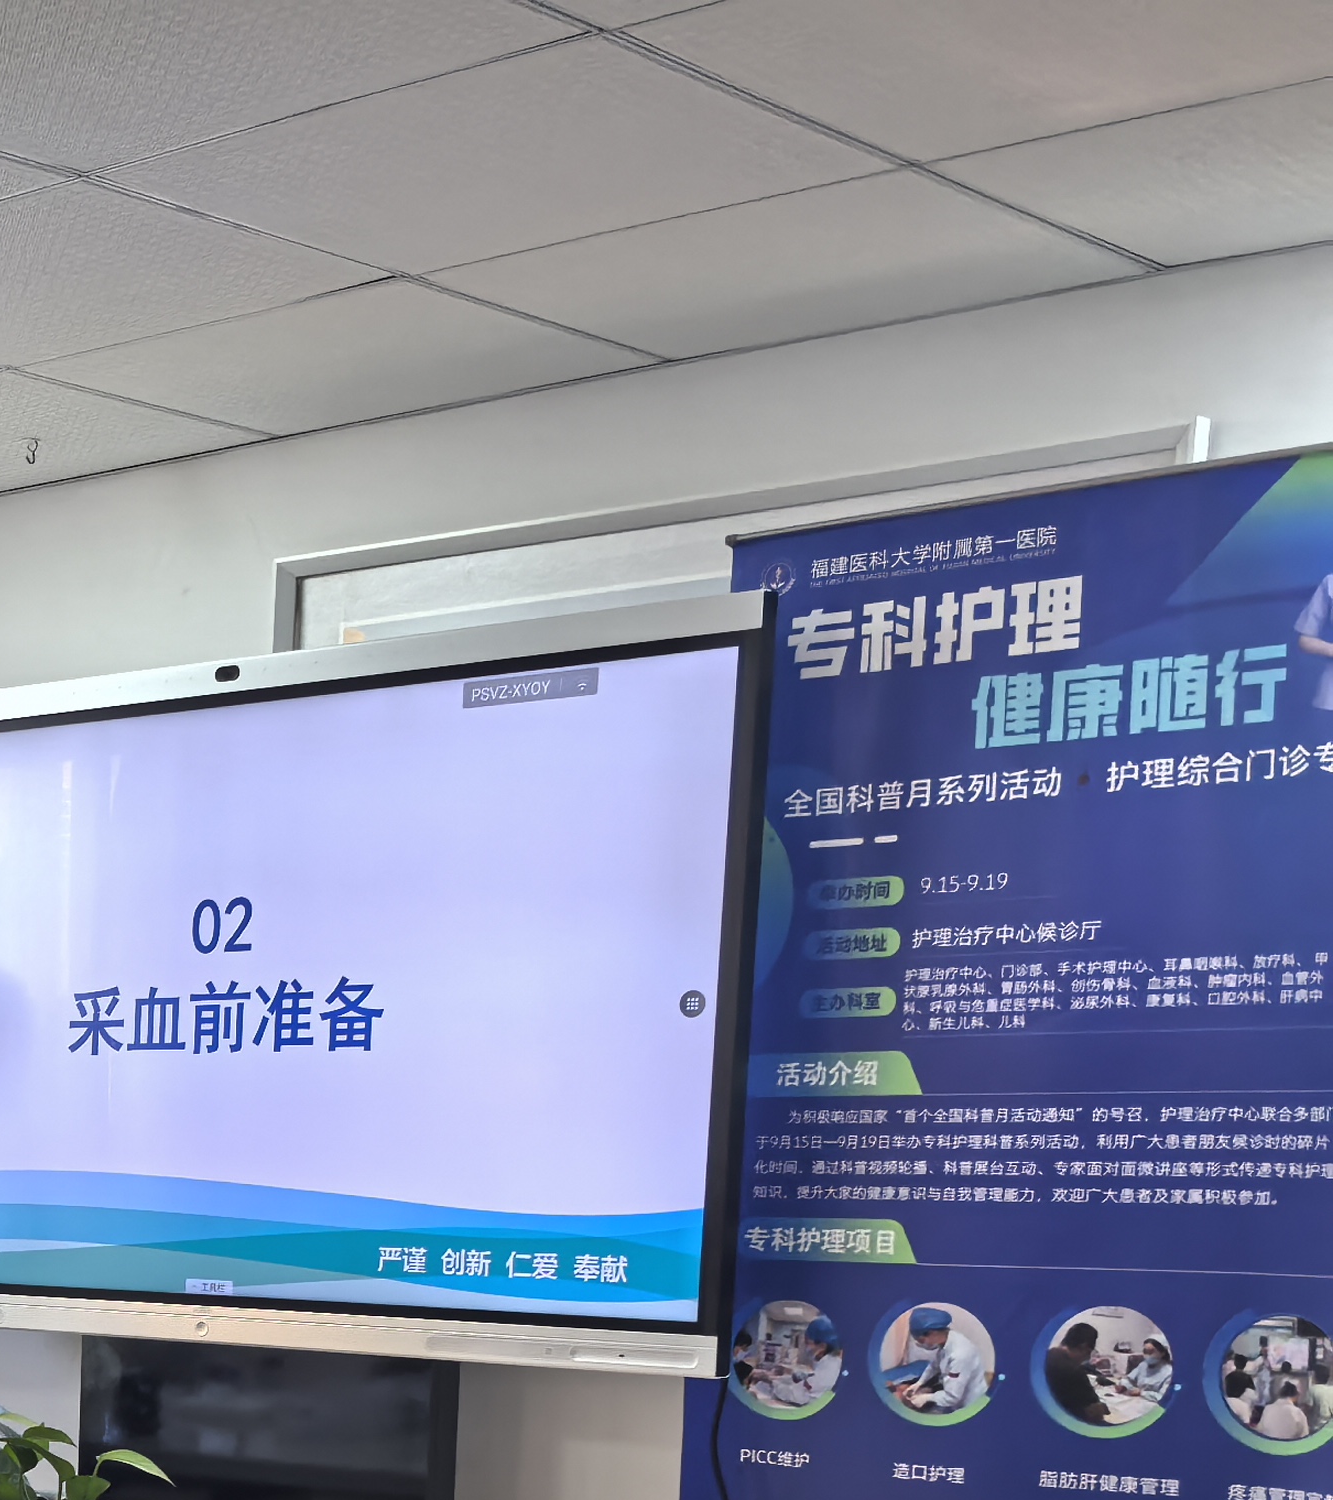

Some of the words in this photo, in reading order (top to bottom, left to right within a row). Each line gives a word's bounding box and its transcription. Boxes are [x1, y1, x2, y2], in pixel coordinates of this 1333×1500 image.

[810, 525, 1058, 579] 福建医科大学附属第一医院
[787, 574, 1083, 681] 专科护理
[971, 643, 1289, 750] 健康随行
[783, 767, 1062, 820] 全国科普月系列活动
[920, 871, 1009, 894] 9.15-9.19
[190, 896, 254, 955] 02
[912, 919, 1103, 949] 护理治疗中心候诊厅
[68, 976, 385, 1057] 采血前准备
[776, 1059, 879, 1088] 活动介绍
[743, 1226, 896, 1256] 专科护理项目
[376, 1245, 428, 1275] 严谨
[440, 1248, 491, 1278] 创新
[504, 1251, 559, 1281] 仁爱
[573, 1253, 629, 1284] 奉献
[740, 1447, 811, 1468] PICC维护
[892, 1462, 966, 1486] 造口护理
[1038, 1468, 1181, 1498] 脂肪肝健康管理
